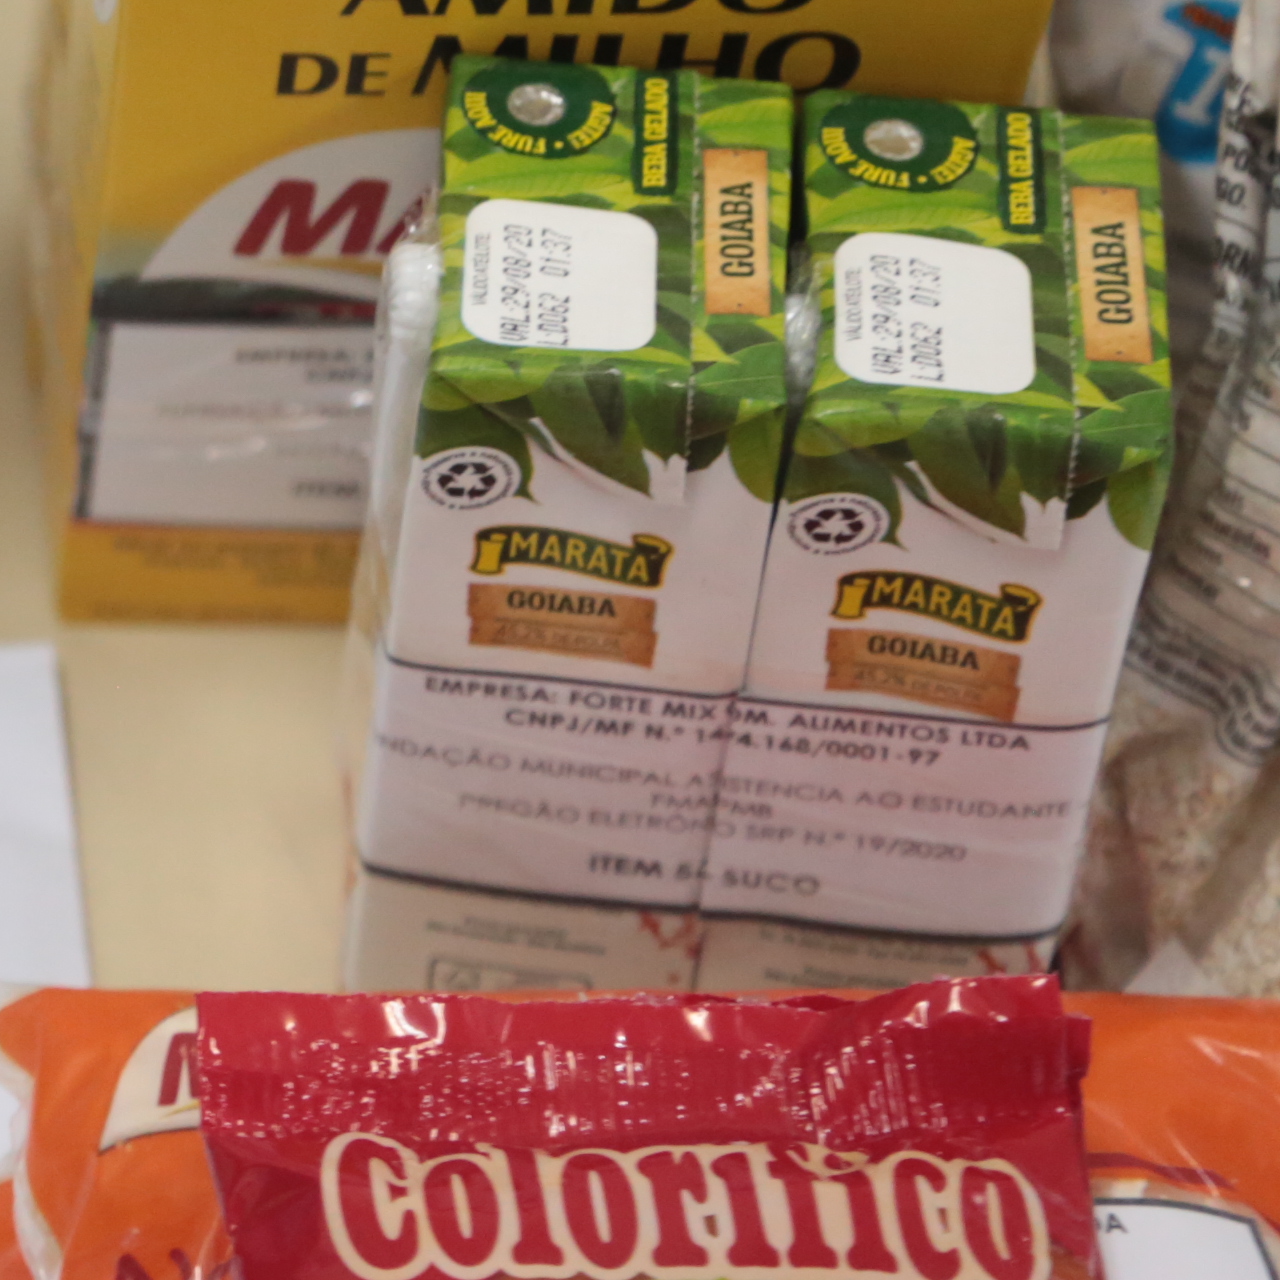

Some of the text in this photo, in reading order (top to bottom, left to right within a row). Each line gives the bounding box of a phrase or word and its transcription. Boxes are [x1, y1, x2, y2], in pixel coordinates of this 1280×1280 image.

[274, 52, 394, 97] DE
[487, 129, 548, 156] FURE
[642, 77, 671, 189] BEBA GELADO
[848, 158, 912, 189] FURE
[1006, 111, 1035, 226] BEBA GELADO
[720, 181, 756, 279] GOIABA
[1092, 221, 1134, 326] GOIABA
[506, 589, 617, 619] GOIABA
[867, 634, 981, 671] GOIABA
[424, 676, 1033, 752] EMPRESA: FORTE MIX ALIMENTOS LTDA
[503, 707, 635, 738] CNPJ/MF
[519, 757, 676, 790] MUNICIPAL
[854, 790, 904, 810] AO
[911, 793, 1072, 820] ESTUDANTE
[854, 833, 969, 863] 19/2020
[588, 853, 663, 881] ITEM
[721, 867, 823, 899] SUCO
